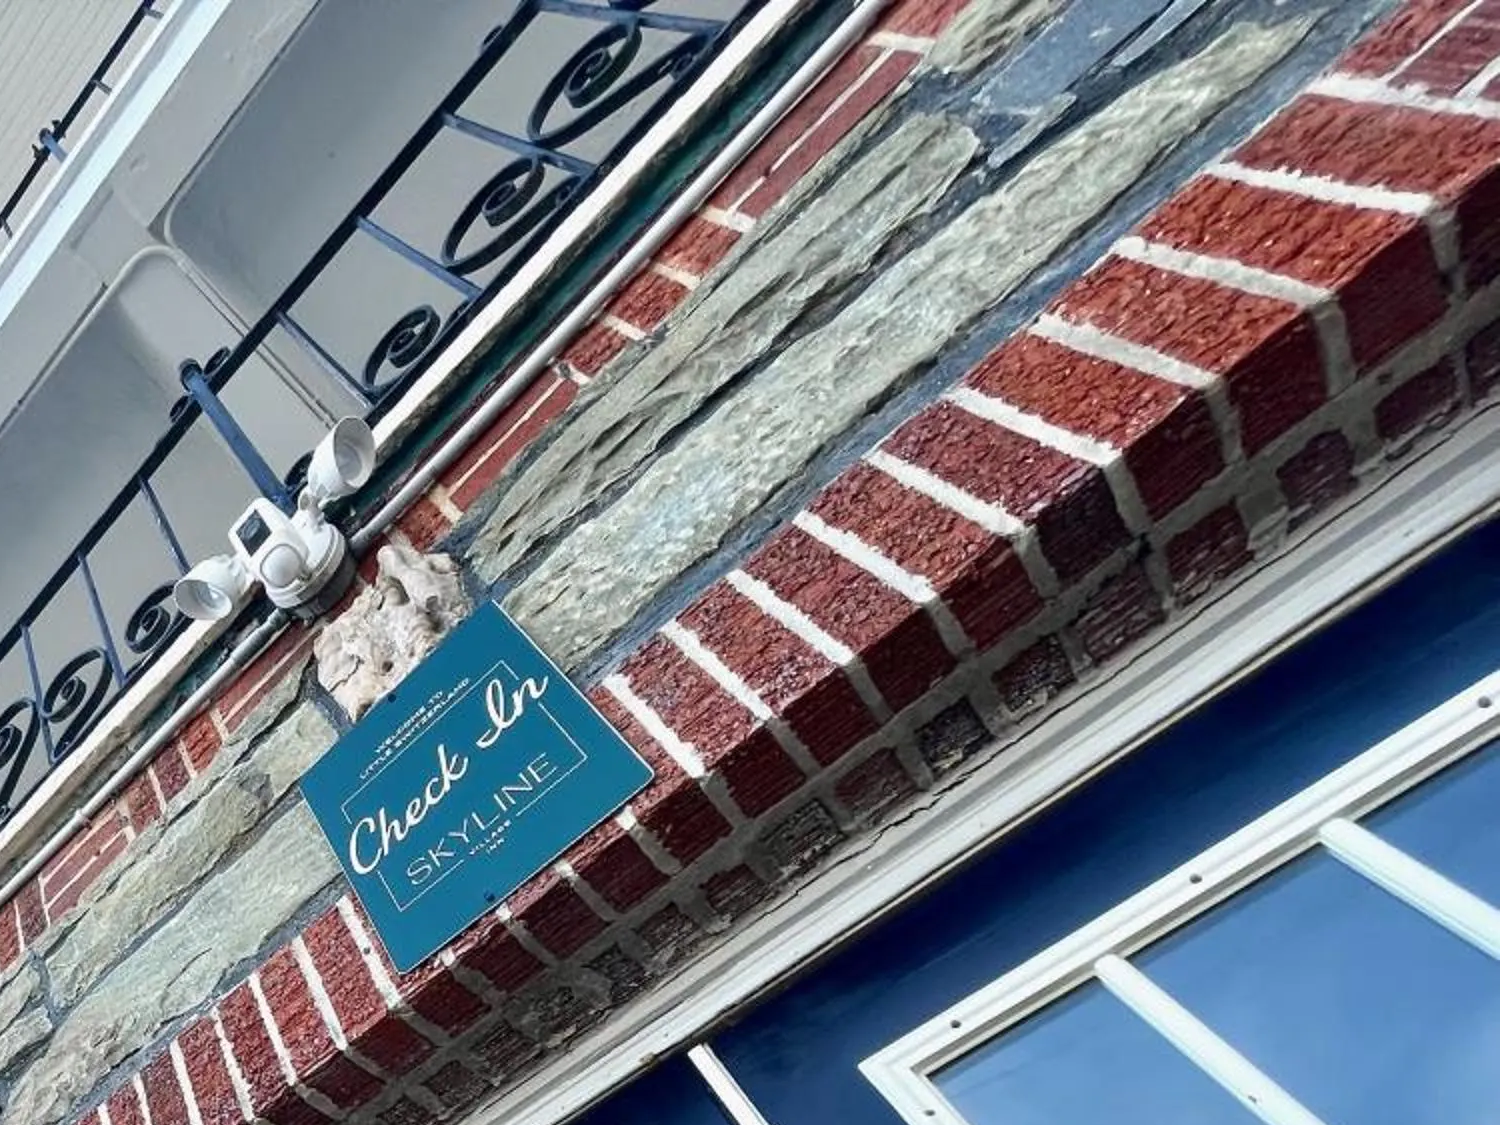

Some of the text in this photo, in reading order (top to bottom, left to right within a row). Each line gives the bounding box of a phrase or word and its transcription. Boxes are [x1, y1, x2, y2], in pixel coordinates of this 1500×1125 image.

[349, 675, 549, 875] Check In
[406, 751, 558, 886] SKYLINE
